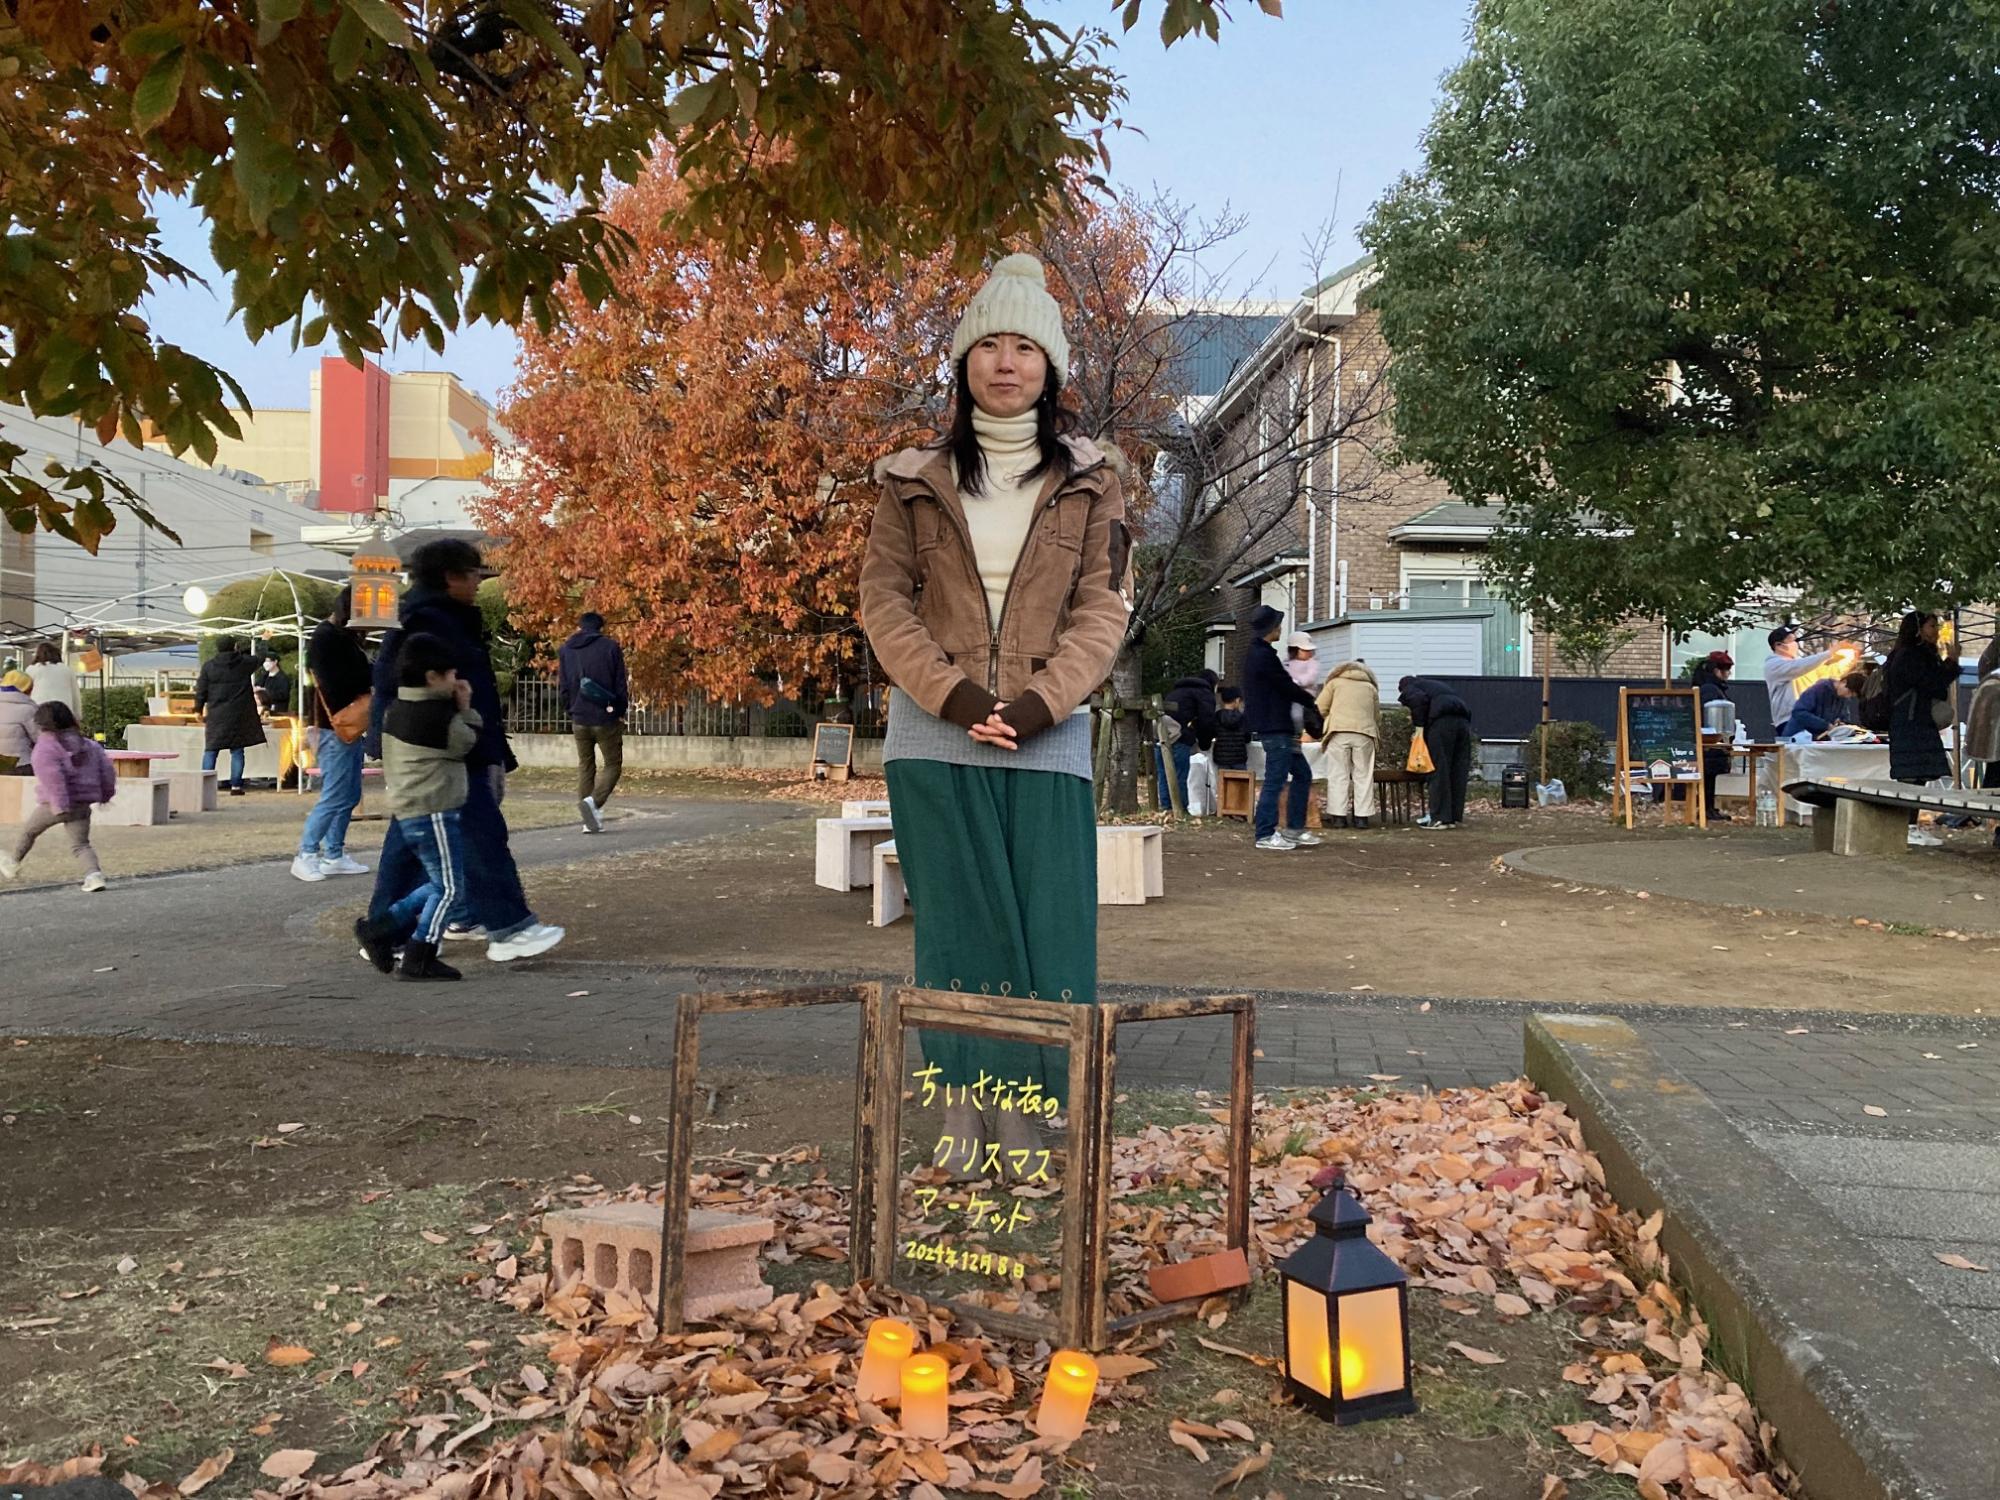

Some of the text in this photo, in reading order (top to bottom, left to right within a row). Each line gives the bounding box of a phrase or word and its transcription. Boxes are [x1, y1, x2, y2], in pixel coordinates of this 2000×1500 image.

[934, 1135, 1051, 1183] クリスマス
[914, 1188, 1033, 1234] マーケット
[906, 1240, 1025, 1280] 2024年12月8日
